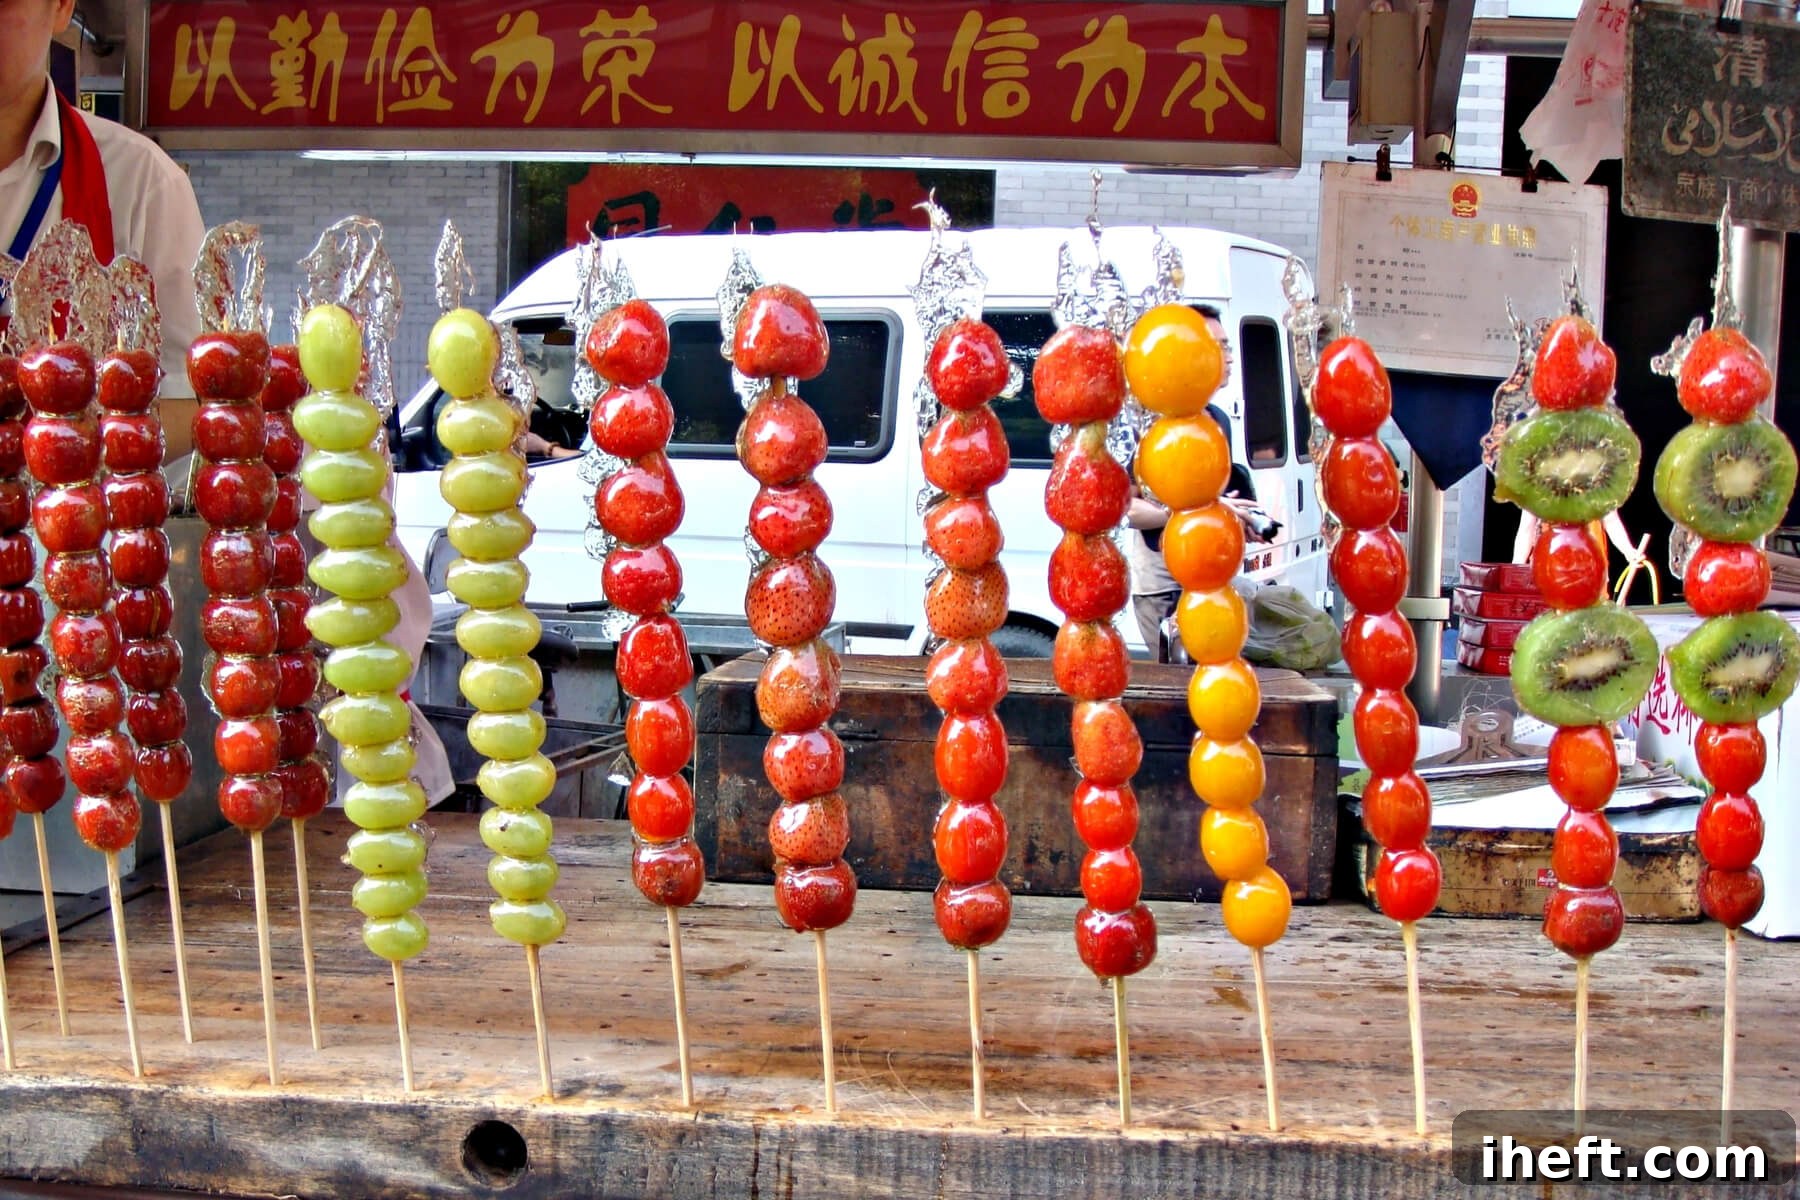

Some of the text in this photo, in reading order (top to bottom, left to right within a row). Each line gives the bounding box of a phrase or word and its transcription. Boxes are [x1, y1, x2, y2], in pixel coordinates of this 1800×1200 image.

[168, 5, 1266, 134] 以勤俭为荣 以诚信为本
